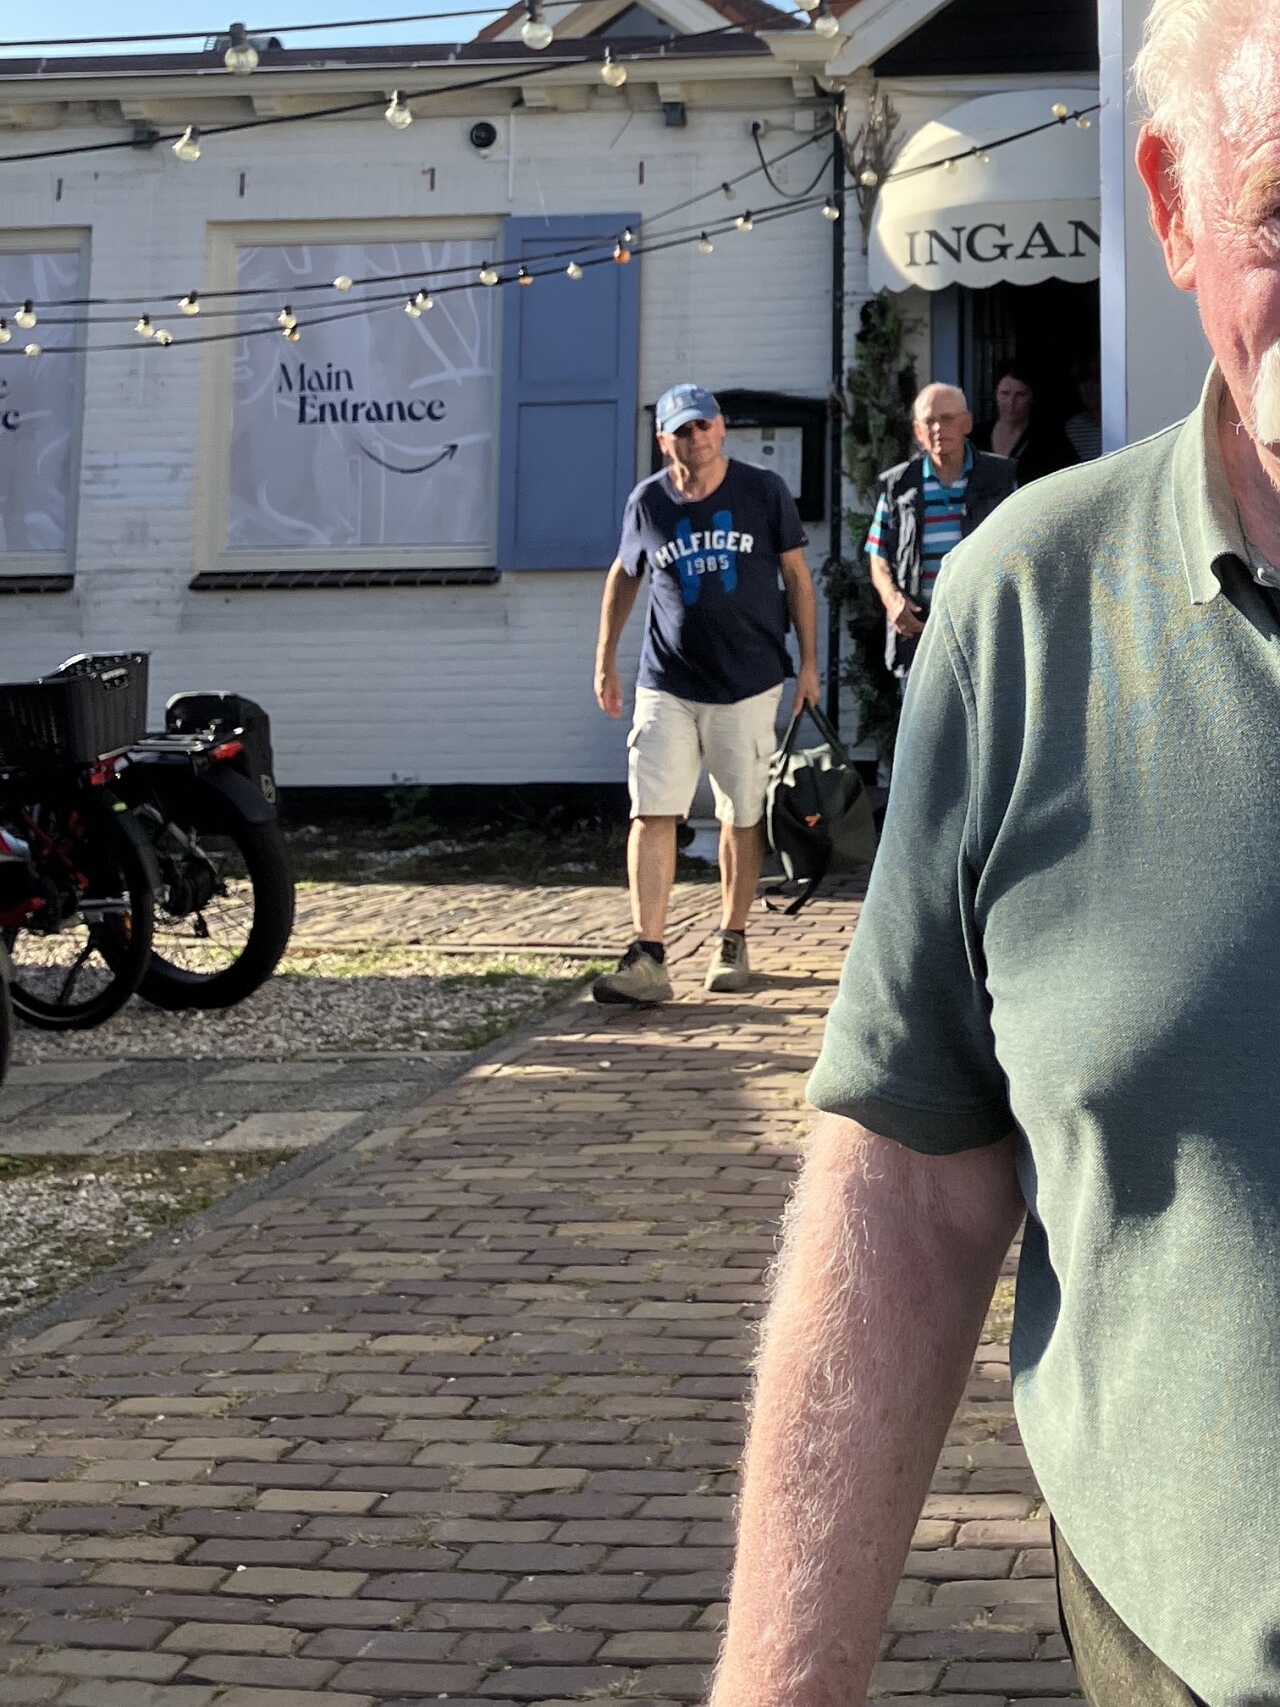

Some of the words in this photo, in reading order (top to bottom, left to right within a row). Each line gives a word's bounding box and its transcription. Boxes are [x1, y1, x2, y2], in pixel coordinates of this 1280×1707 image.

[278, 362, 354, 393] Main
[298, 395, 447, 425] Entrance
[656, 530, 754, 569] HILFIGER
